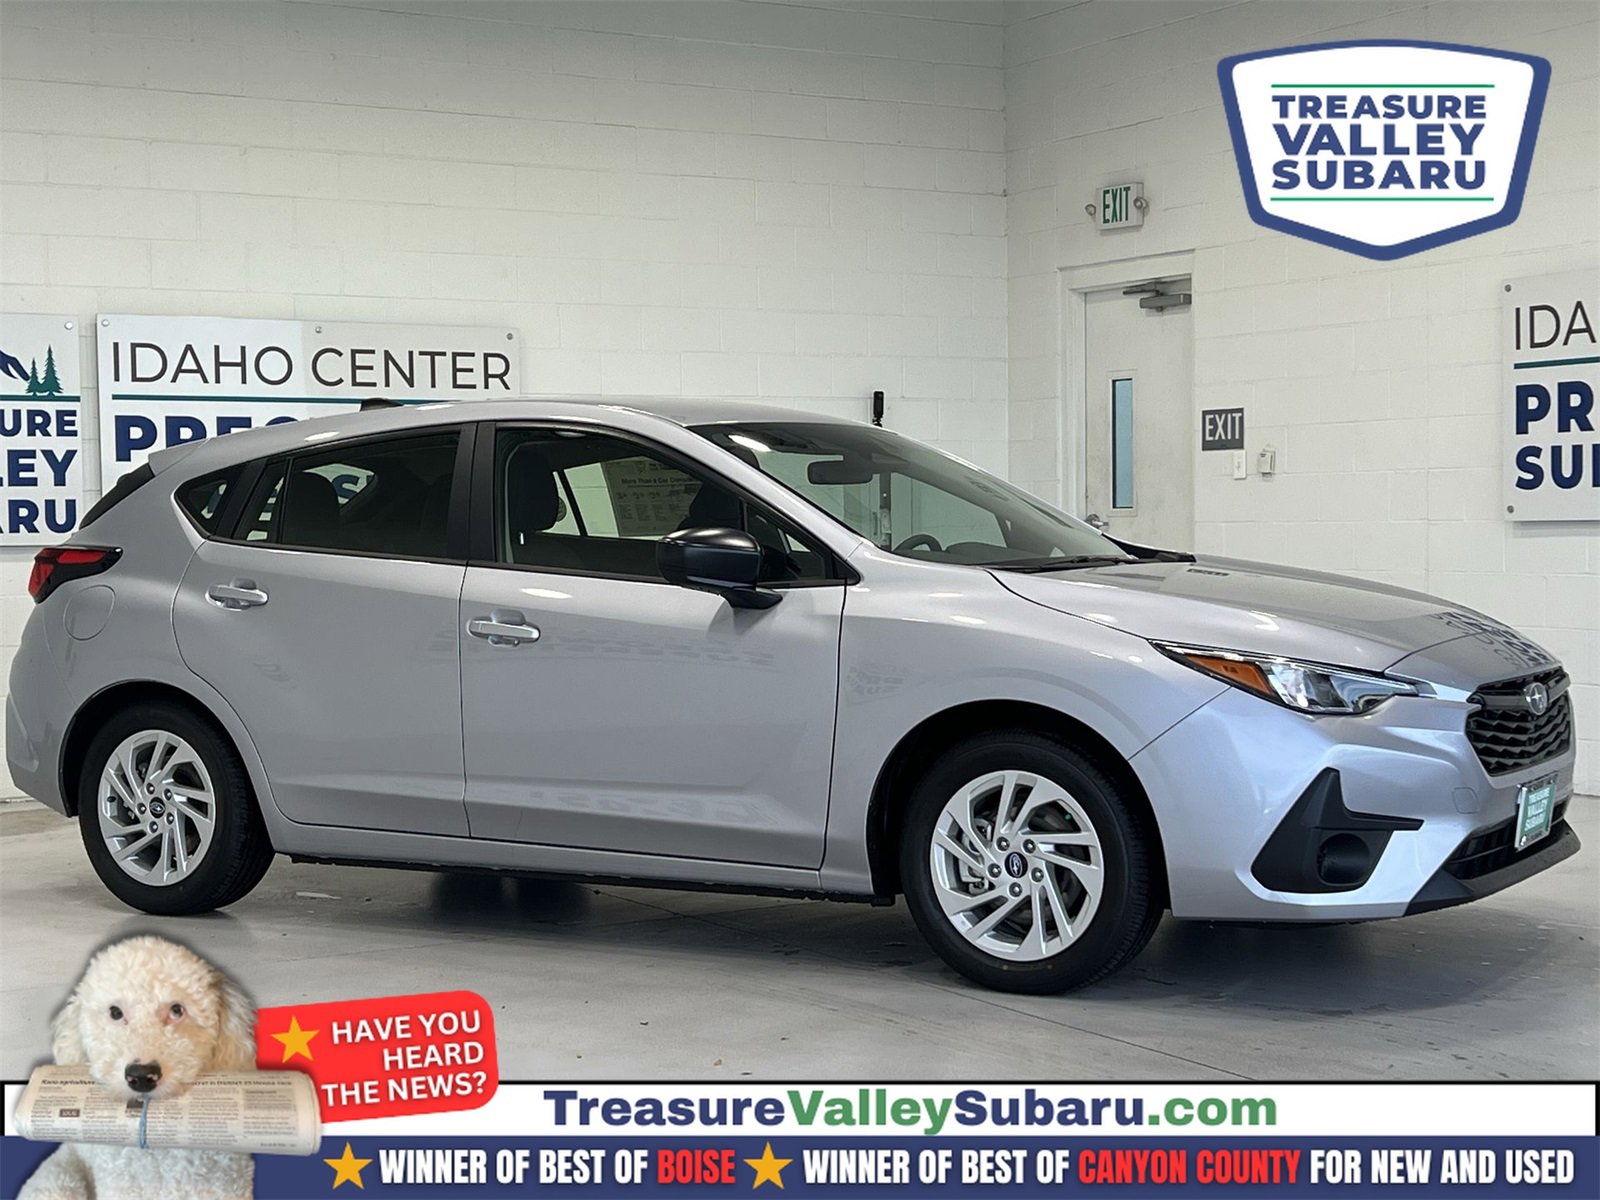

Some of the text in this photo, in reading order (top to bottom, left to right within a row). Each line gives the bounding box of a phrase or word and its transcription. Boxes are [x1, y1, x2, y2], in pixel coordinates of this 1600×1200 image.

[1102, 186, 1131, 224] EXIT
[1515, 300, 1597, 350] IDA
[112, 341, 511, 390] IDAHO CENTER
[1205, 412, 1242, 441] EXIT
[0, 449, 78, 487] EY
[0, 499, 77, 534] RU
